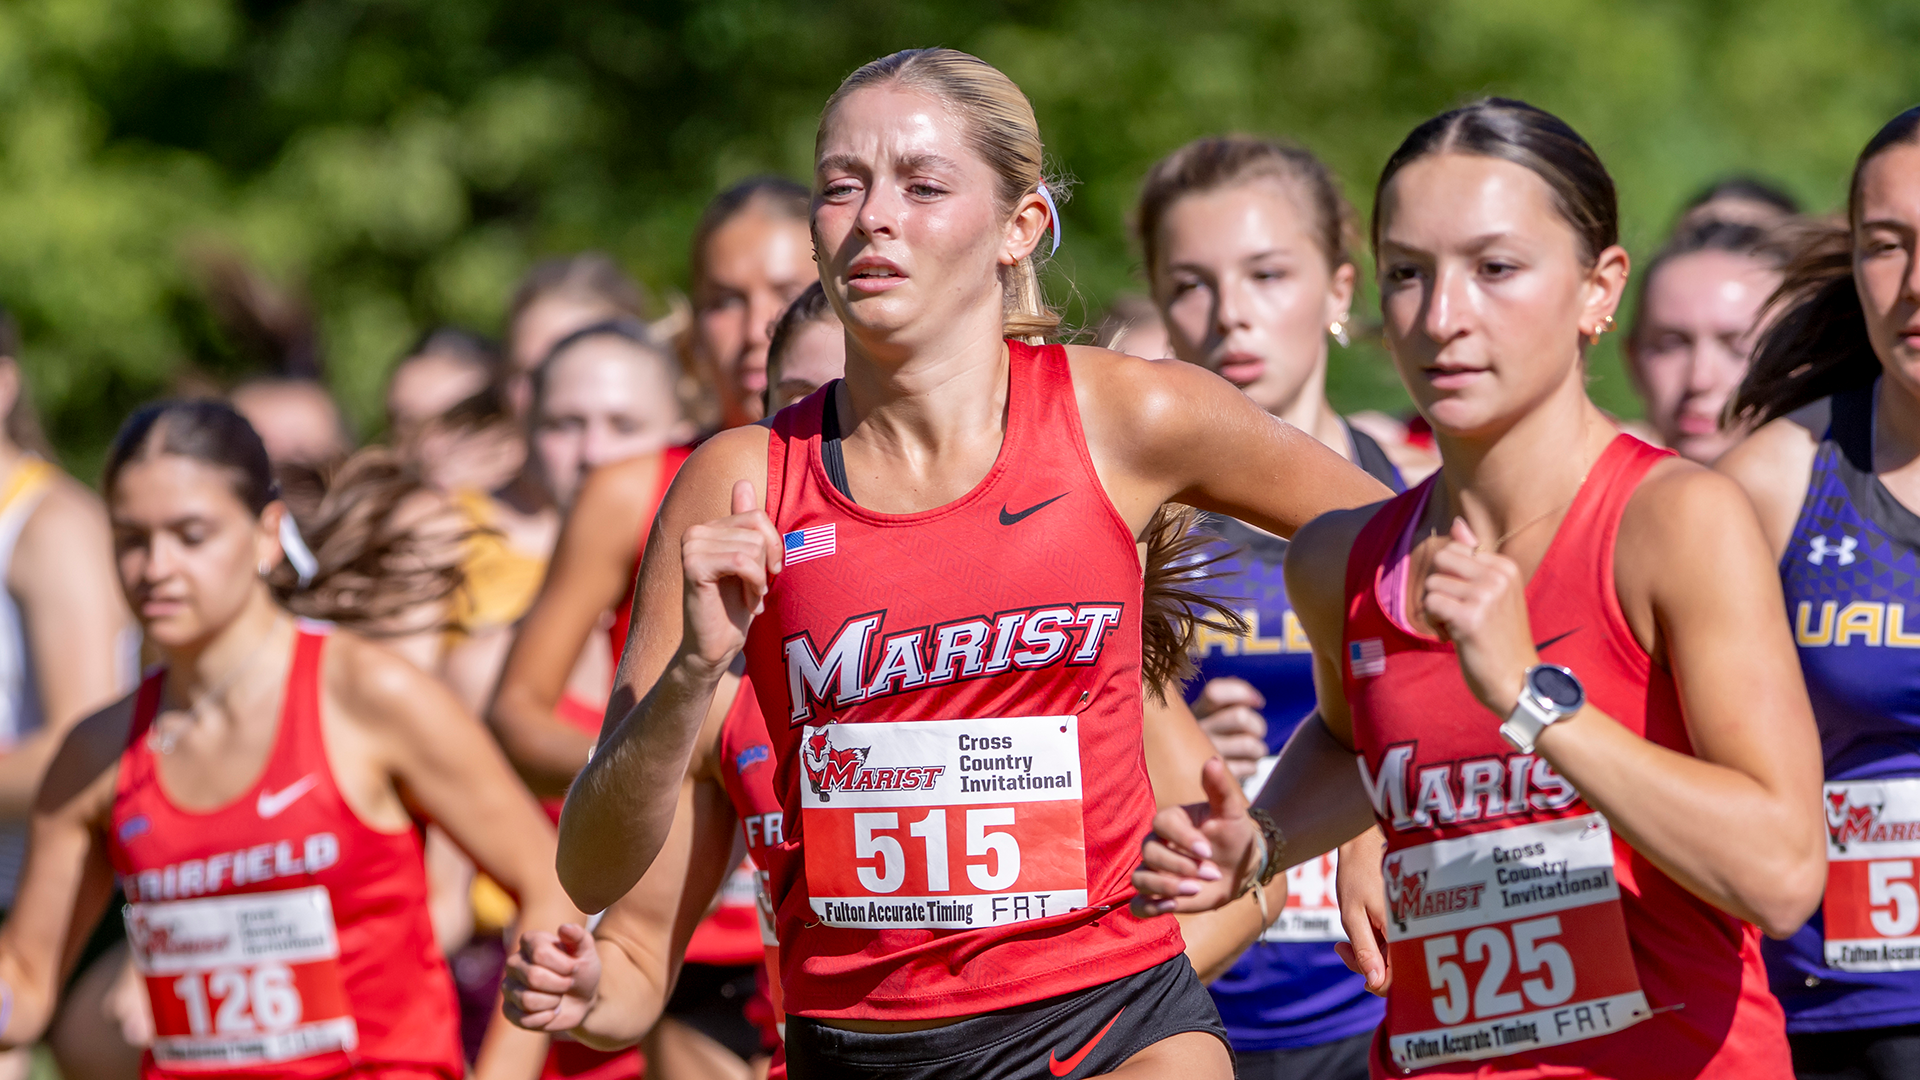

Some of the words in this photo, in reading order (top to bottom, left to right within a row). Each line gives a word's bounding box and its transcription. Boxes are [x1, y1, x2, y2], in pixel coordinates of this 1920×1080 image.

[1795, 600, 1920, 648] UAL
[783, 602, 1125, 729] MARIST
[958, 734, 1013, 751] Cross
[819, 760, 946, 792] MARIST
[959, 754, 1033, 773] Country
[960, 771, 1072, 793] Invitational
[1357, 740, 1581, 831] MARIS
[853, 807, 1021, 894] 515
[1492, 841, 1546, 865] Cross
[1496, 858, 1568, 886] Country
[1500, 871, 1609, 908] Invitational
[824, 902, 865, 922] Fulton
[868, 901, 925, 923] Accurate
[927, 900, 973, 925] Timing
[1399, 880, 1487, 920] MARIST
[1423, 916, 1576, 1025] 525
[172, 965, 303, 1038] 126
[1405, 1038, 1440, 1061] Fulton
[1442, 1029, 1492, 1054] Accurate
[1492, 1020, 1540, 1046] Timing
